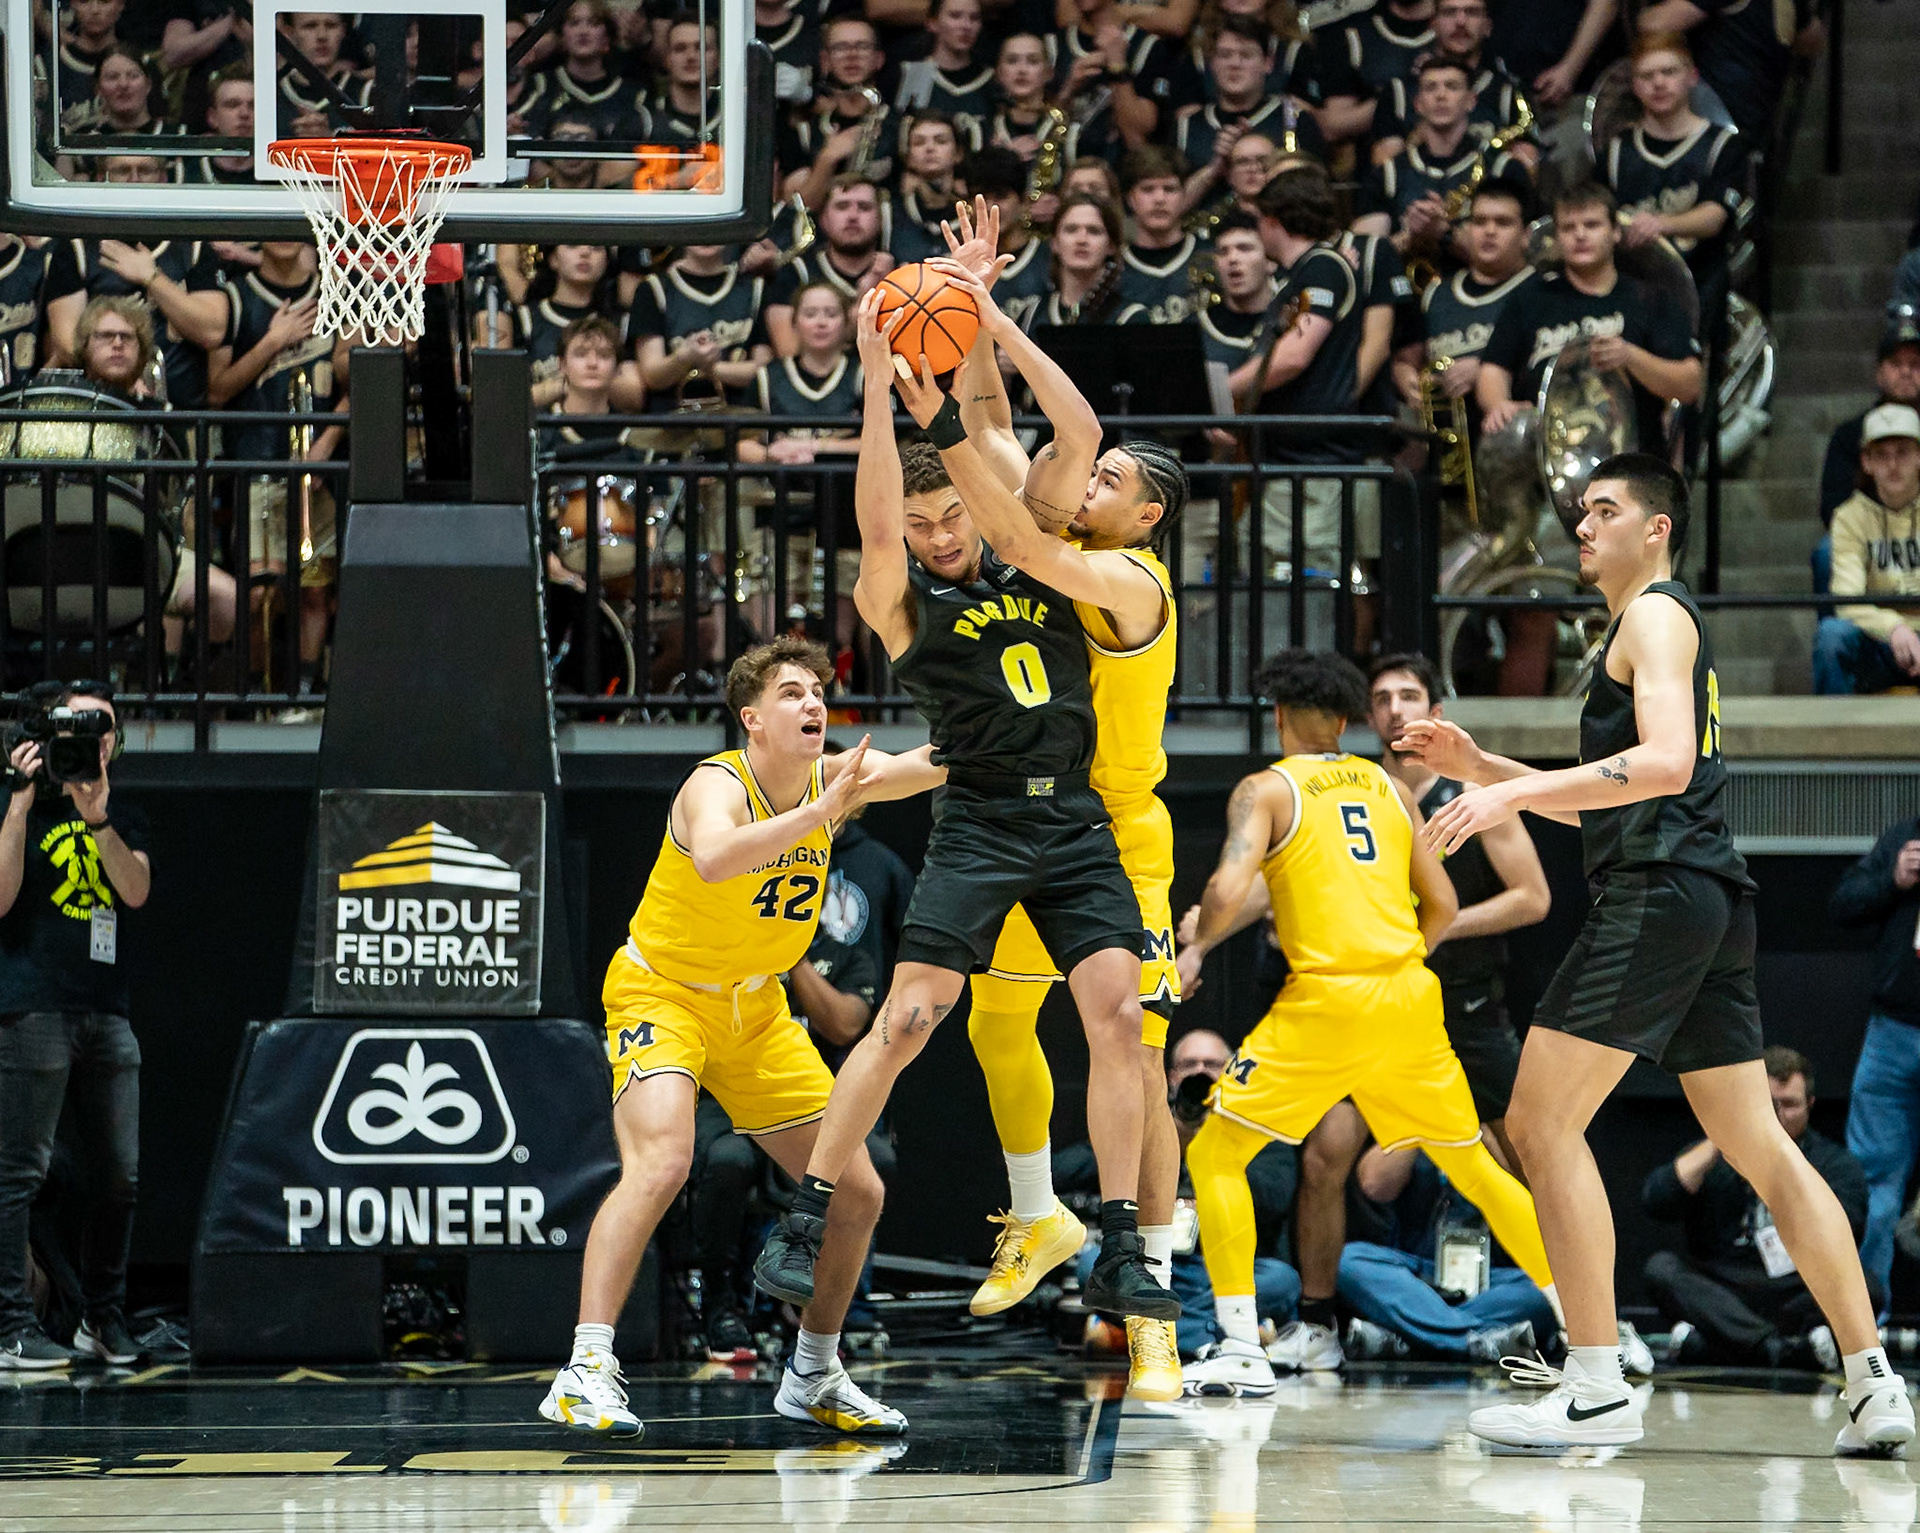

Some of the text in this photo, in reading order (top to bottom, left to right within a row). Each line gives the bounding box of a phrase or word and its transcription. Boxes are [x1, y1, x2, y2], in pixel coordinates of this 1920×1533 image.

[953, 594, 1048, 640] PURDUE
[1000, 641, 1052, 709] 0
[1303, 770, 1372, 797] WILLIAMS
[1339, 804, 1377, 862] 5
[746, 846, 827, 875] HIGAN
[337, 897, 520, 933] PURDUE
[751, 873, 820, 922] 42
[335, 933, 519, 967] FEDERAL
[1143, 928, 1173, 961] M
[334, 967, 519, 987] CREDIT UNION
[618, 1021, 656, 1058] M
[1225, 1052, 1259, 1086] M
